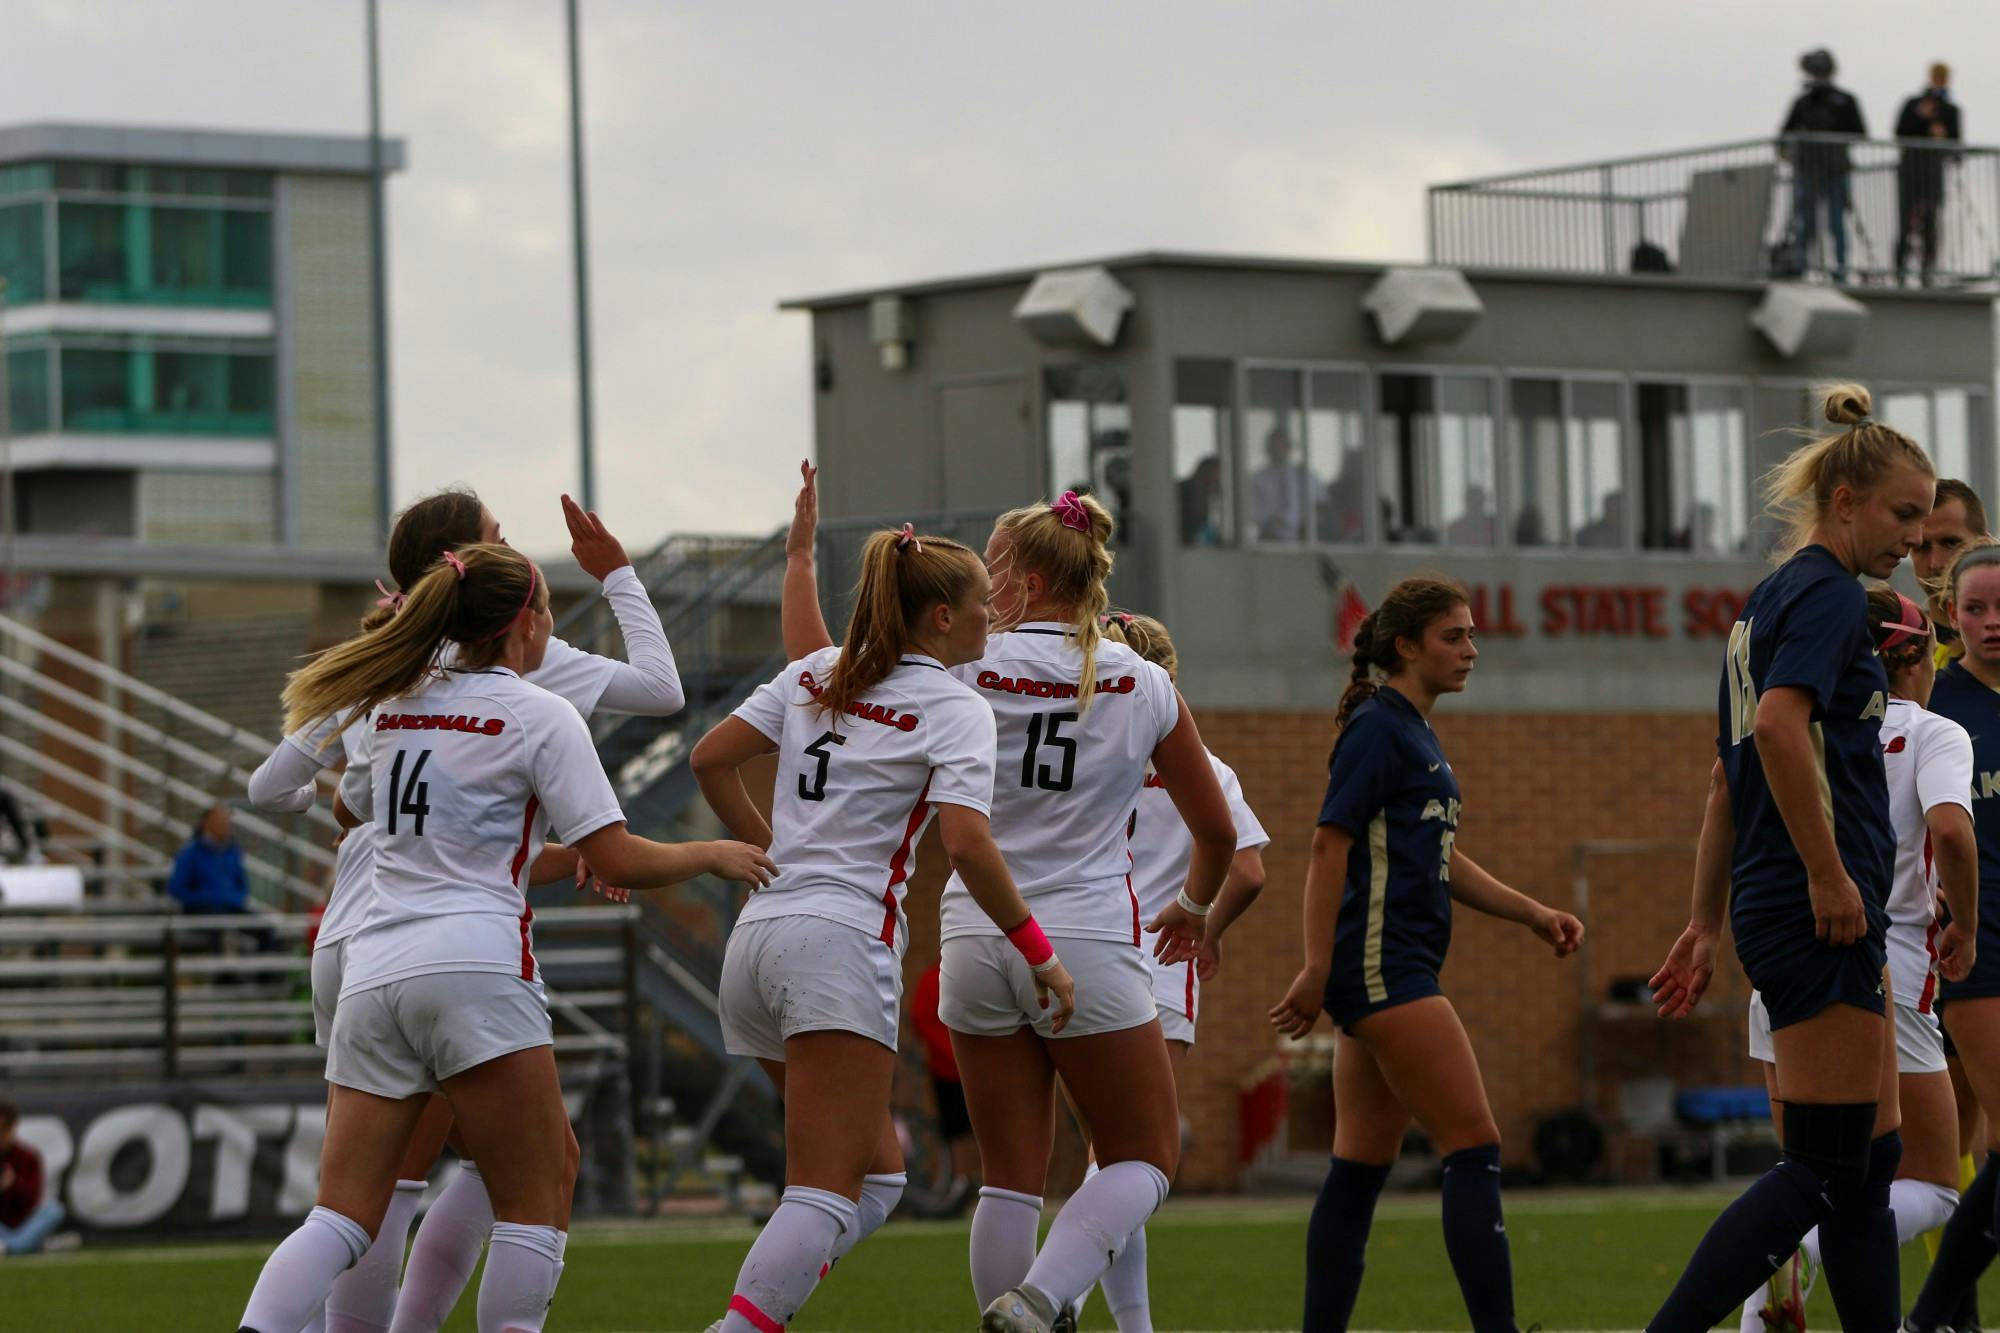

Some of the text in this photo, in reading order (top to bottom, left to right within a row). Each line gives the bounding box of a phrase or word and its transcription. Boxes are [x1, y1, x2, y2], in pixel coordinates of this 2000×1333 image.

[1472, 584, 1752, 638] LL STATE SO
[977, 671, 1136, 699] CARDINLS
[376, 714, 506, 736] CARDINALS
[1021, 712, 1079, 792] 15
[388, 750, 432, 836] 14
[799, 731, 847, 801] 5
